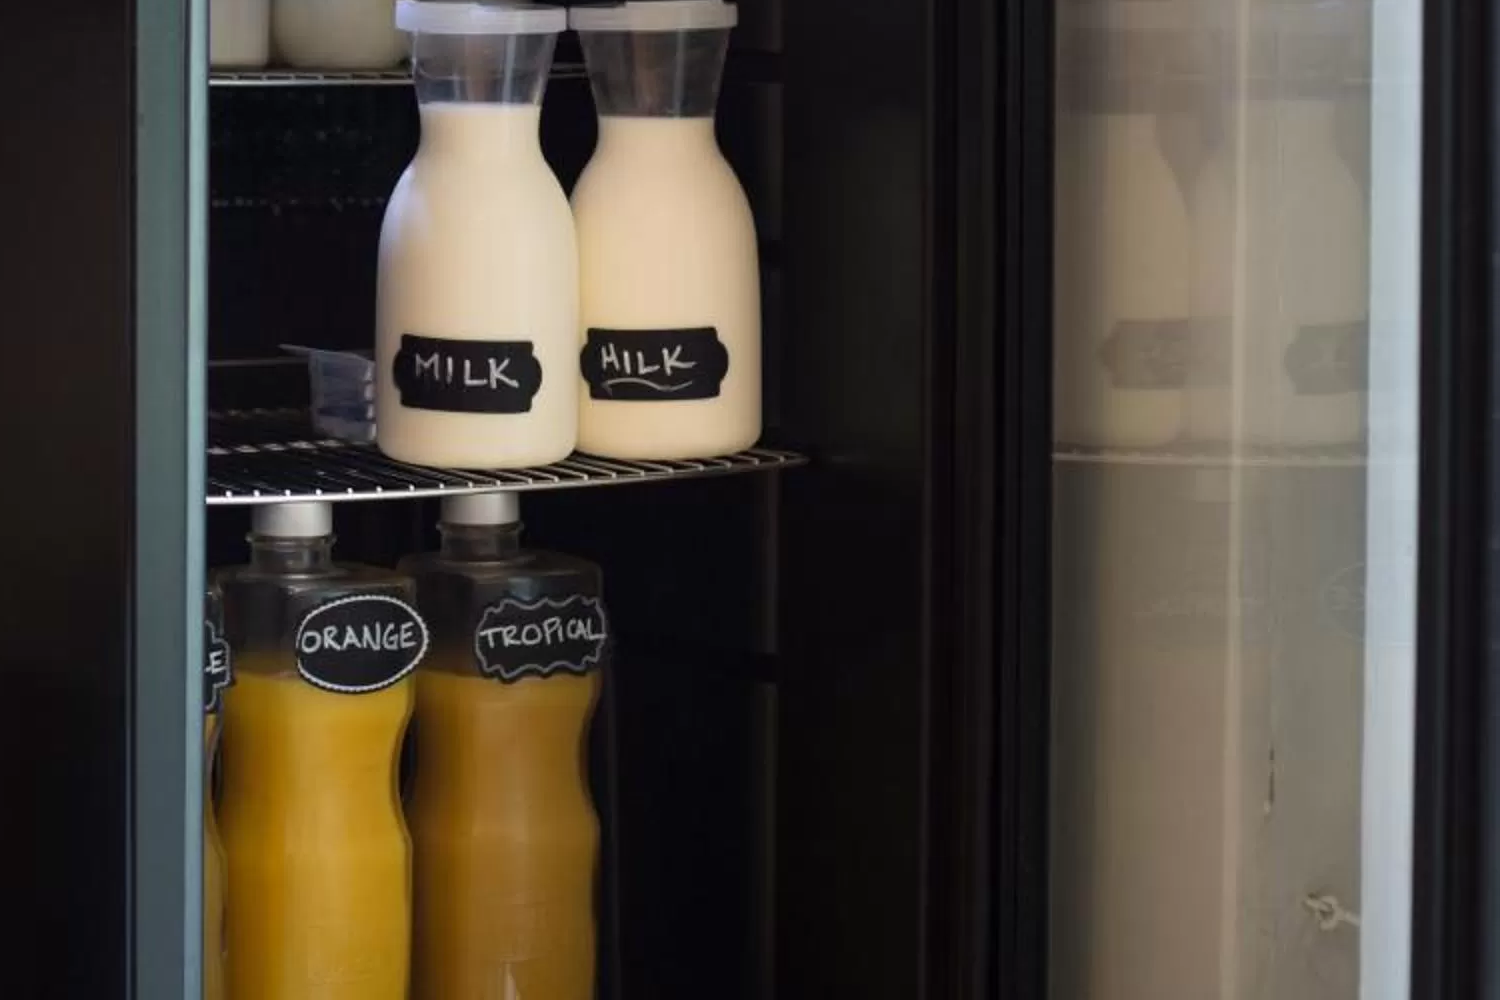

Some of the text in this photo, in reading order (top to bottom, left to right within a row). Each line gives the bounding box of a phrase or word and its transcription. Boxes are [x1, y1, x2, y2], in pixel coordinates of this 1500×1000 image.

[414, 352, 520, 390] MILK
[300, 620, 418, 654] ORANGE
[478, 615, 606, 650] TROPICAL
